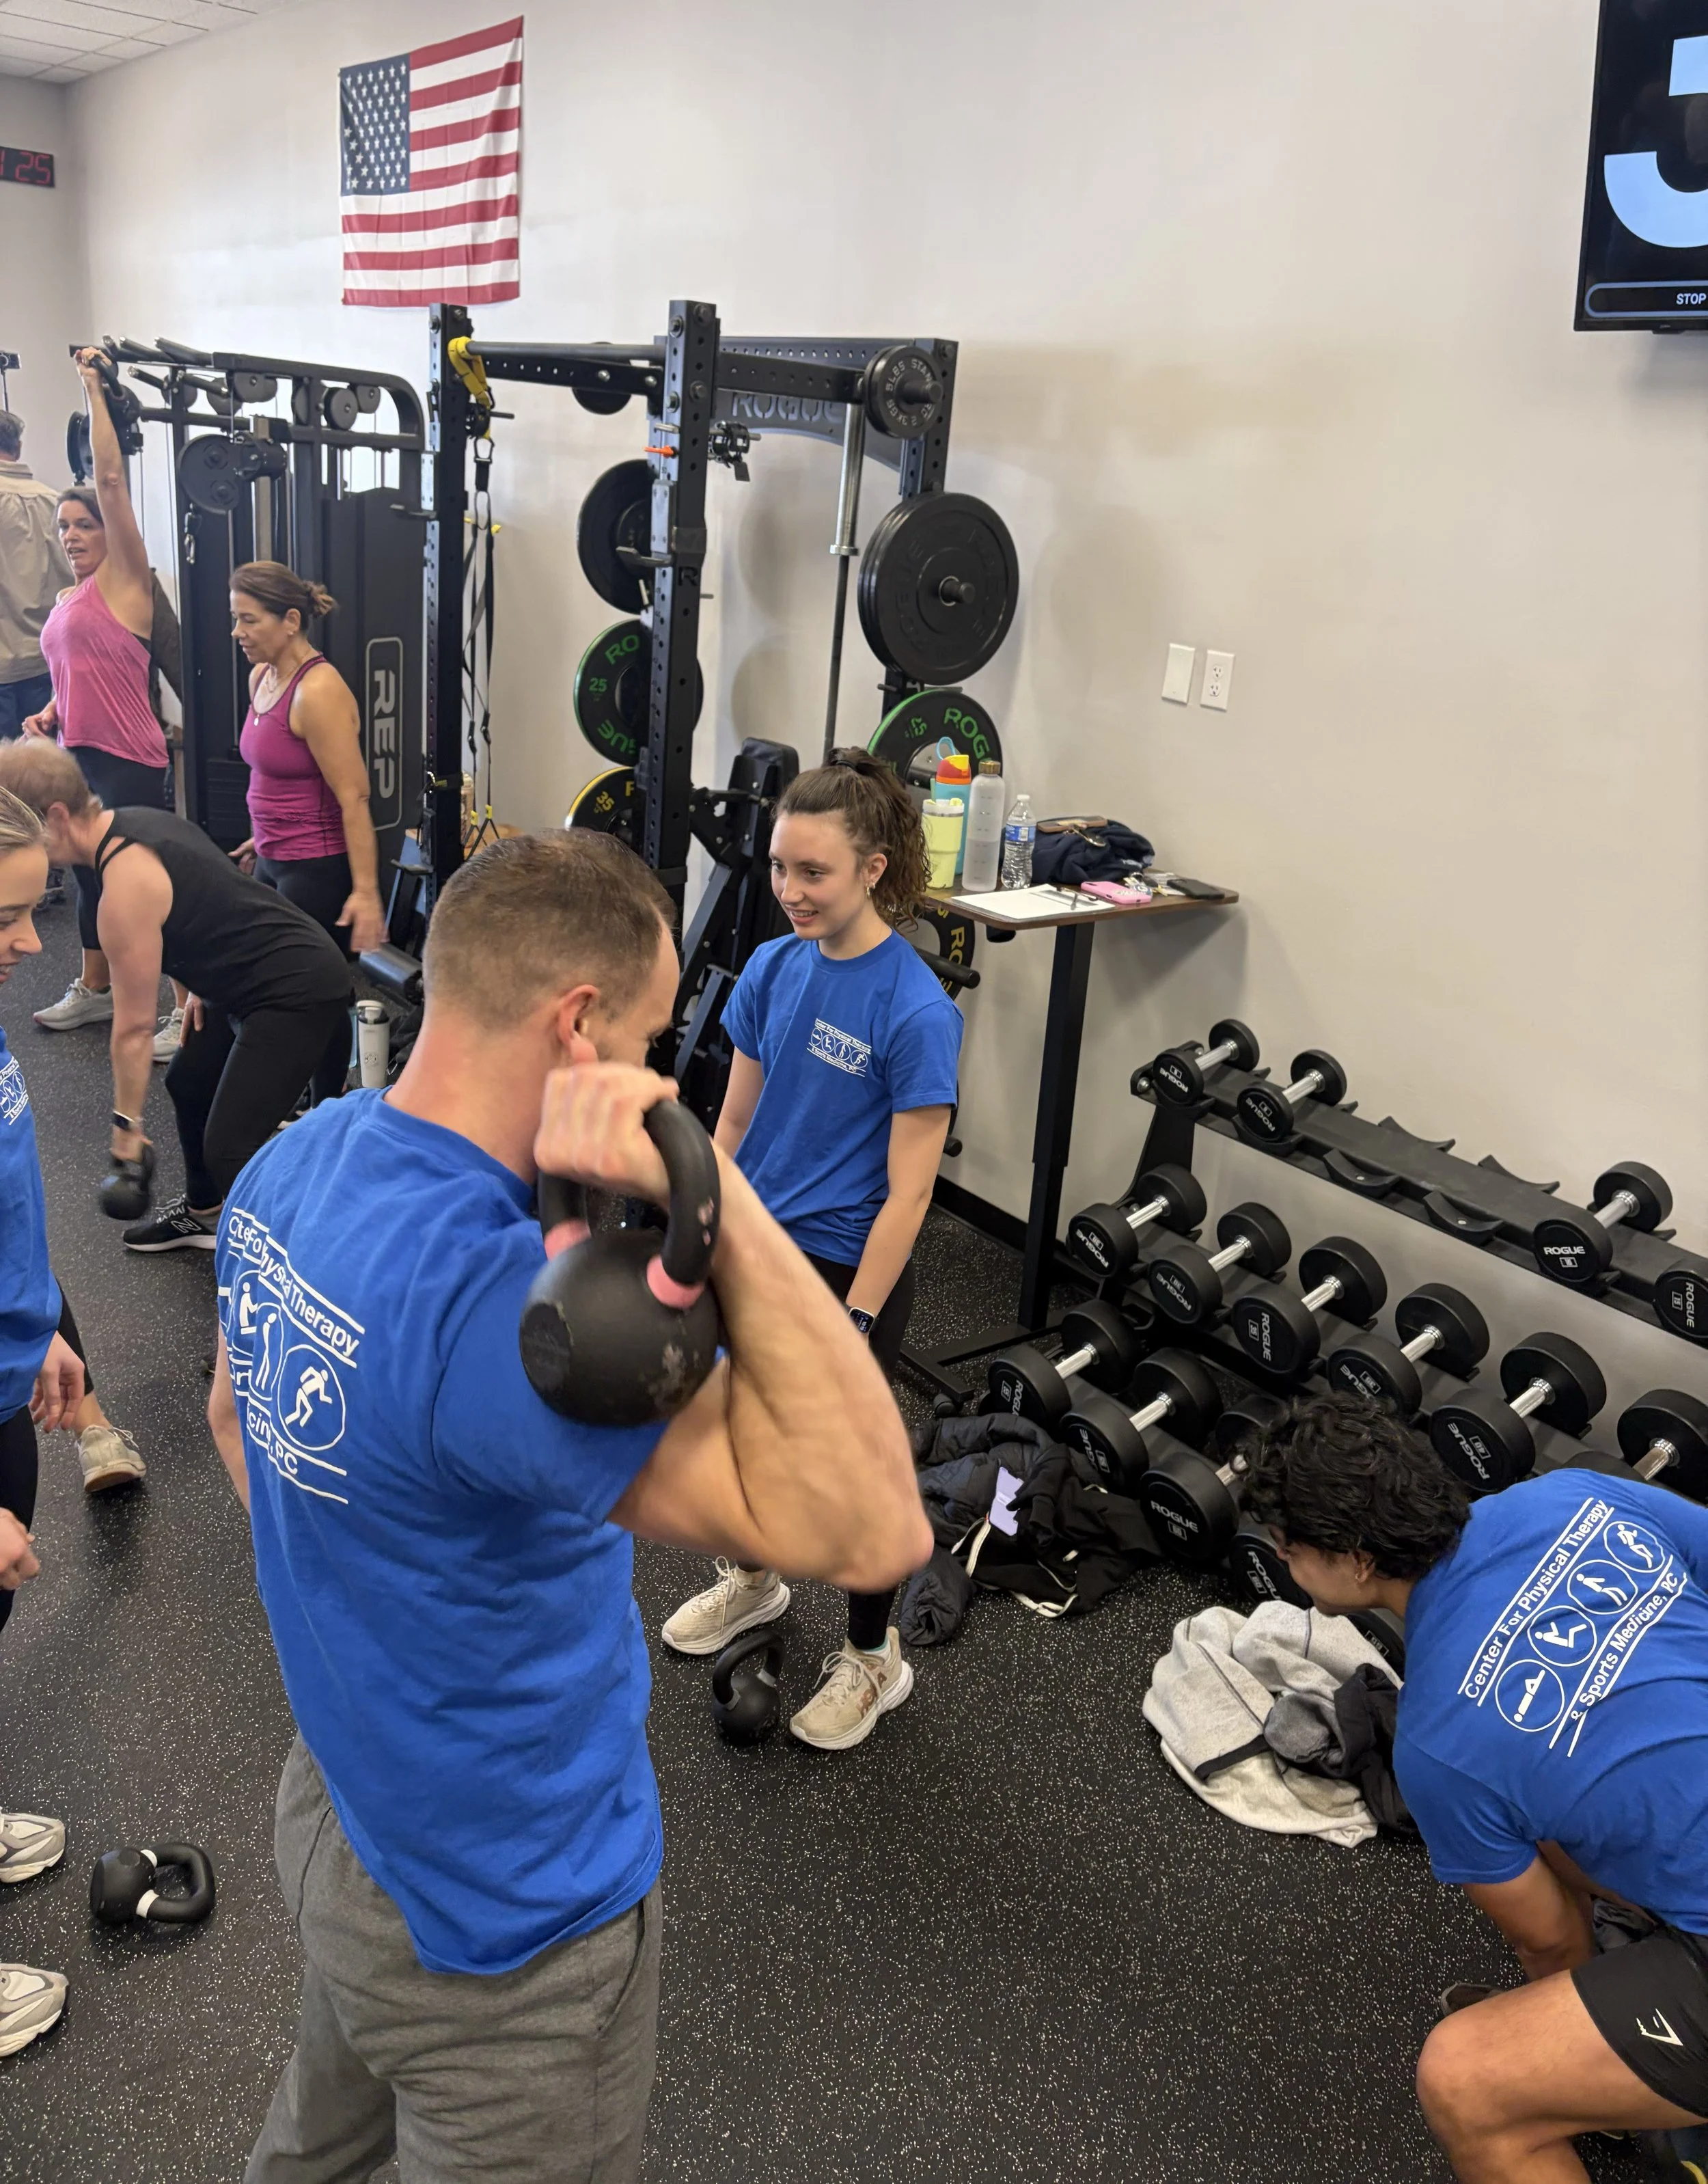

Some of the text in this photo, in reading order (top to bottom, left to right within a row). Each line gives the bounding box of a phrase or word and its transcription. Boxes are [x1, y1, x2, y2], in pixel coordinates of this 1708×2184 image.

[1676, 292, 1707, 305] STOP
[589, 677, 607, 692] 25
[374, 669, 396, 799] REP
[944, 708, 990, 759] ROG
[596, 791, 615, 810] 35
[1159, 1067, 1188, 1093] ROGUE
[1245, 1097, 1276, 1132] ROGUE
[1076, 1229, 1109, 1268] ROGUE
[1543, 1246, 1586, 1255] ROGUE
[1156, 1272, 1192, 1311] ROGUE
[1685, 1282, 1695, 1328] ROGUE
[290, 1283, 360, 1358] Therapy
[1261, 1312, 1271, 1361] ROGUE
[1012, 1380, 1023, 1416] ROGU
[275, 1441, 298, 1475] PC
[1448, 1422, 1490, 1479] ROGUE
[1151, 1500, 1199, 1533] ROGUE
[1248, 1551, 1282, 1600] ROGU
[1465, 1500, 1608, 1698] Center For Physical Therapy
[1579, 1652, 1619, 1706] Sports
[1610, 1594, 1668, 1652] Medicine,
[1661, 1572, 1678, 1594] PC
